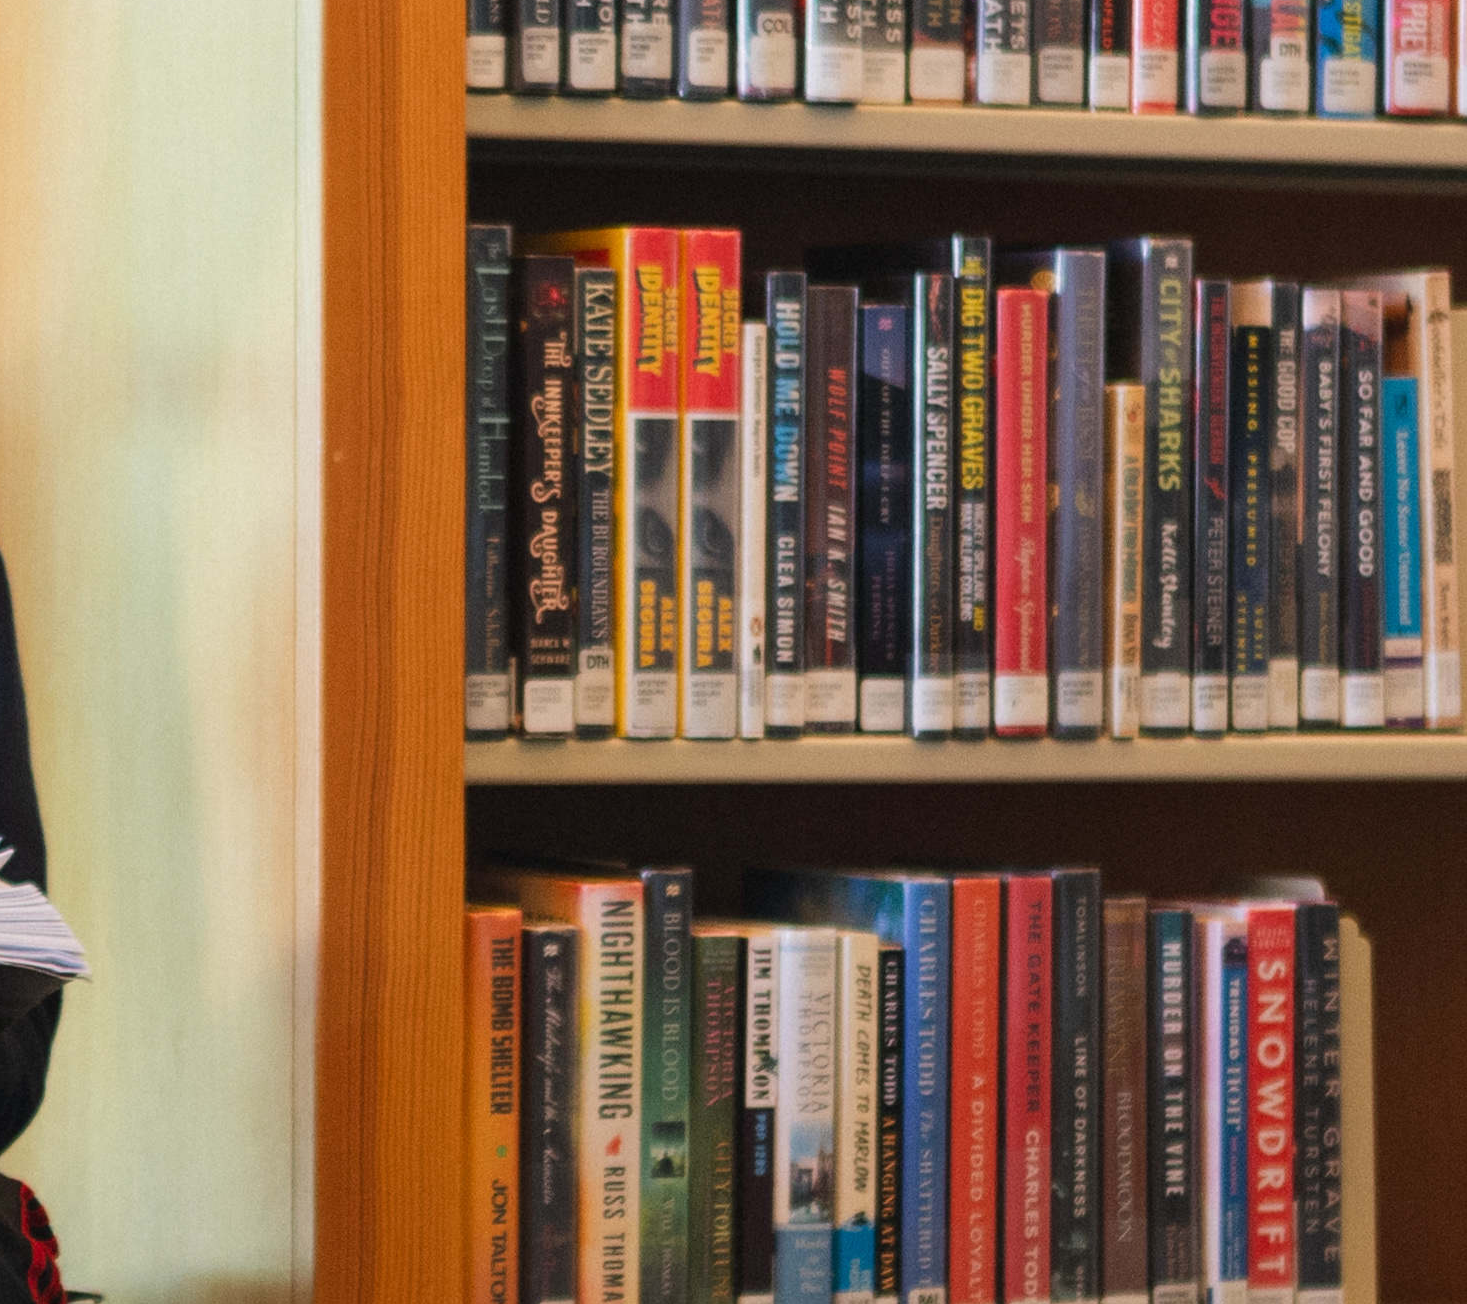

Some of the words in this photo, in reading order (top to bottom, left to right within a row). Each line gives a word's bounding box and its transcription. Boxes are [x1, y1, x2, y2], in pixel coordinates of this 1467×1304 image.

[585, 282, 613, 358] KATE
[637, 266, 658, 376] IDENTITY
[694, 267, 719, 376] IDENTITY
[776, 302, 799, 370] HOLD
[962, 287, 983, 327] DIG
[1159, 279, 1182, 347] CITY
[828, 368, 846, 420] WOLF
[926, 347, 947, 408] SALLY
[962, 333, 983, 390] TWO
[1320, 361, 1333, 429] BABY'S
[1359, 371, 1374, 400] SO
[584, 366, 613, 478] SEDLEY
[776, 378, 798, 416] ME
[1159, 368, 1182, 491] SHARKS
[1359, 406, 1374, 447] FAR
[531, 380, 562, 503] INNKEEPER'S
[776, 424, 798, 502] DOWN
[828, 427, 846, 488] POINT
[926, 412, 947, 509] SPENCER
[962, 397, 983, 489] GRAVES
[1319, 435, 1333, 492] FIRST
[1359, 455, 1374, 501] AND
[827, 505, 846, 540] IAN
[1318, 499, 1332, 577] FELONY
[1358, 509, 1373, 577] GOOD
[531, 510, 568, 624] DAUGHTER
[777, 536, 794, 588] CLEA
[639, 581, 653, 668] SEGURA
[695, 581, 711, 668] SEGURA
[777, 596, 794, 663] SIMON
[827, 579, 845, 643] SMITH
[492, 936, 515, 971] THE
[663, 913, 682, 991] BLOOD
[753, 947, 771, 978] JIM
[491, 975, 515, 1032] BOMB
[599, 900, 633, 1119] NIGHTHAWKING
[663, 998, 681, 1016] IS
[855, 966, 871, 1023] DEATH
[884, 961, 898, 1047] CHARLES
[1163, 942, 1182, 1035] MURDER
[491, 1035, 514, 1115] SHELTER
[662, 1022, 680, 1100] BLOOD
[753, 989, 771, 1100] THOMPSON
[855, 1029, 871, 1083] COMES
[1074, 1036, 1087, 1079] LINE
[1164, 1049, 1182, 1078] ON
[856, 1091, 871, 1112] TO
[884, 1055, 897, 1106] TODD
[1074, 1086, 1087, 1110] OF
[1165, 1091, 1183, 1132] THE
[1258, 960, 1285, 1274] SNOWDRIFT
[854, 1121, 871, 1192] MARLOW
[881, 1135, 896, 1216] HANGING
[1024, 1130, 1040, 1237] CHARLES
[1073, 1118, 1087, 1218] DARKNESS
[1165, 1143, 1183, 1197] VINE
[491, 1179, 510, 1224] JON
[604, 1167, 625, 1219] RUSS
[881, 1223, 896, 1246] AT
